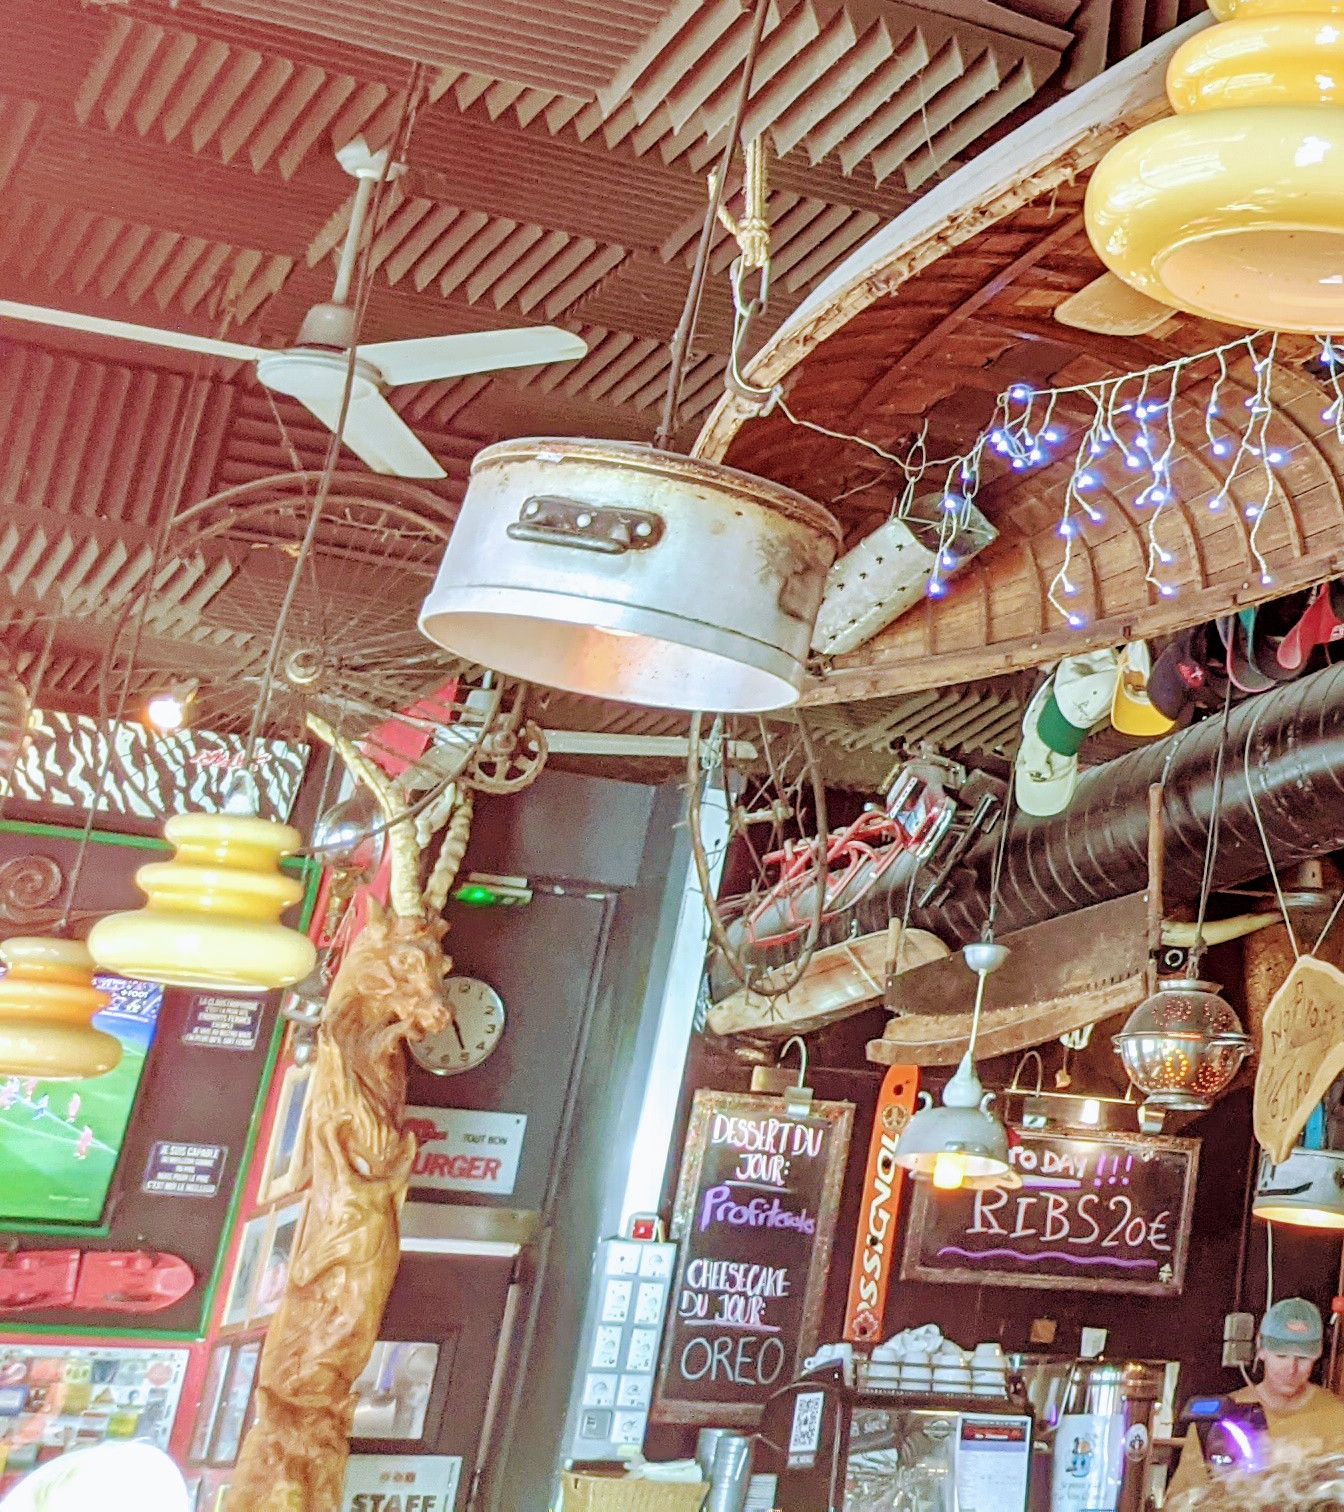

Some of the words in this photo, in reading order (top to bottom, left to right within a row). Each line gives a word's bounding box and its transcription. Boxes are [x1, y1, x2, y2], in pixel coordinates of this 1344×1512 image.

[711, 1113, 794, 1154] DESSERT
[791, 1123, 824, 1158] DU
[411, 1152, 503, 1182] URGER
[966, 1188, 1101, 1244] RIBS
[1101, 1194, 1173, 1252] 20€
[686, 1258, 792, 1297] CHEESECAKE
[678, 1291, 709, 1318] DU
[680, 1335, 785, 1386] OREO
